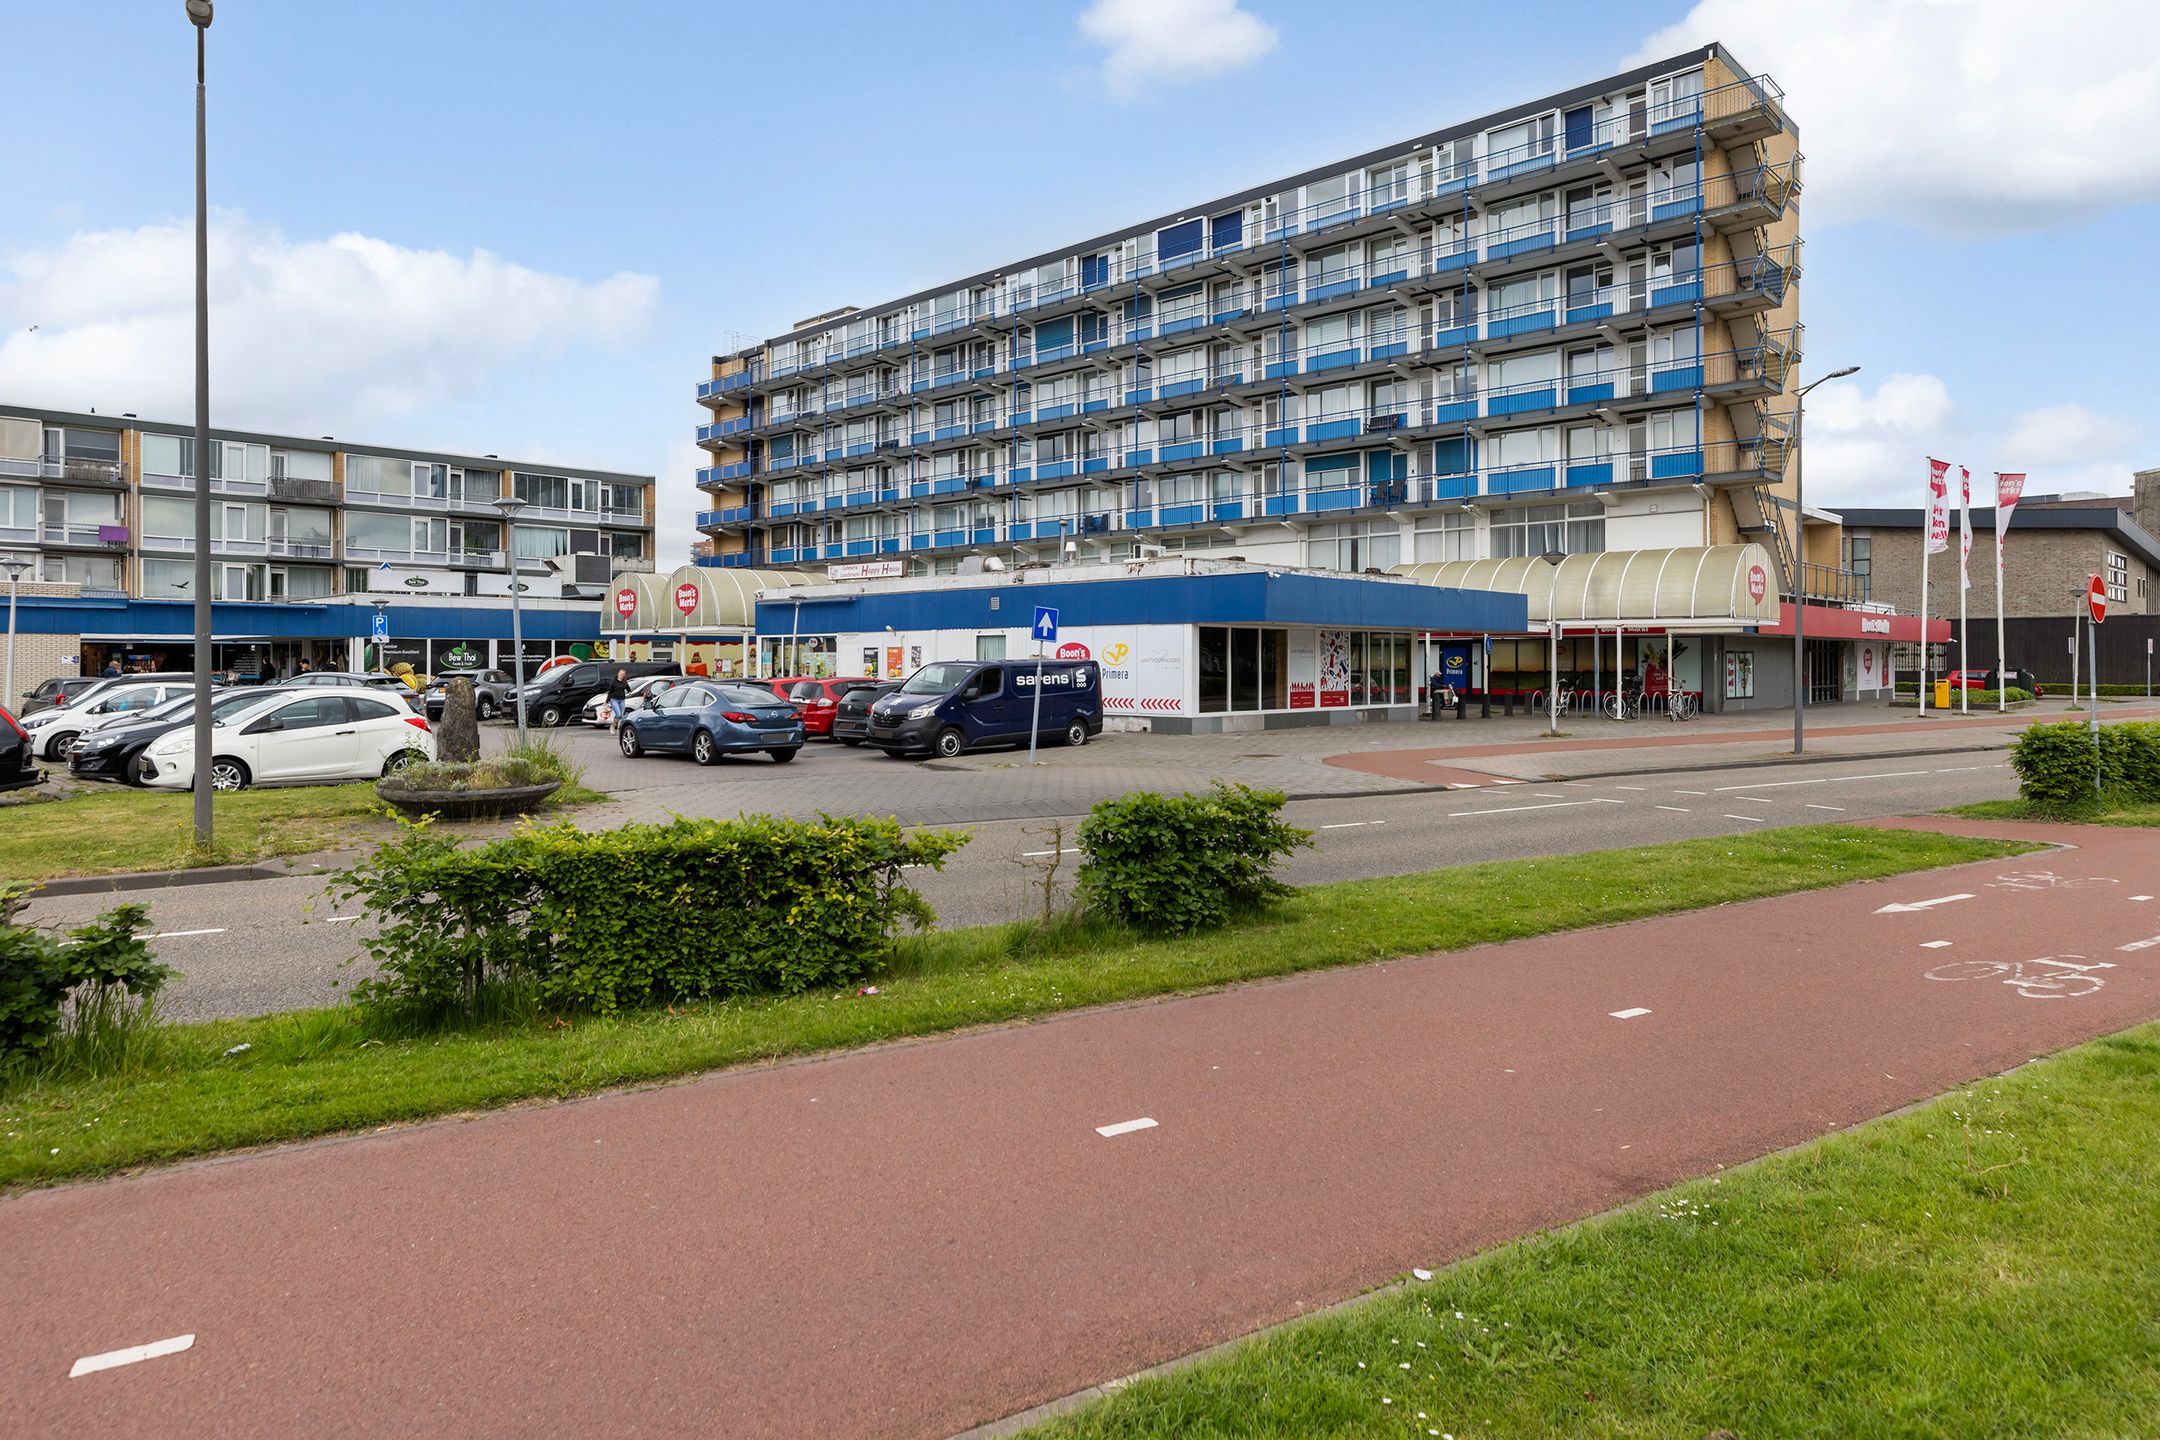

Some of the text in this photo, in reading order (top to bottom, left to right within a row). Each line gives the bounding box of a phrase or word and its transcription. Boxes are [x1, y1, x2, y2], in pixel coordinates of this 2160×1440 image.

[861, 563, 901, 577] Happy House
[1750, 570, 1764, 583] Boon's
[678, 587, 696, 599] Boon's
[1751, 582, 1764, 594] Markt
[618, 593, 635, 603] Boon's
[679, 597, 696, 607] Markt
[619, 602, 634, 611] Markt
[375, 617, 385, 628] P
[463, 652, 477, 662] Thai
[1060, 647, 1086, 658] Boon's
[1102, 667, 1129, 680] Primera
